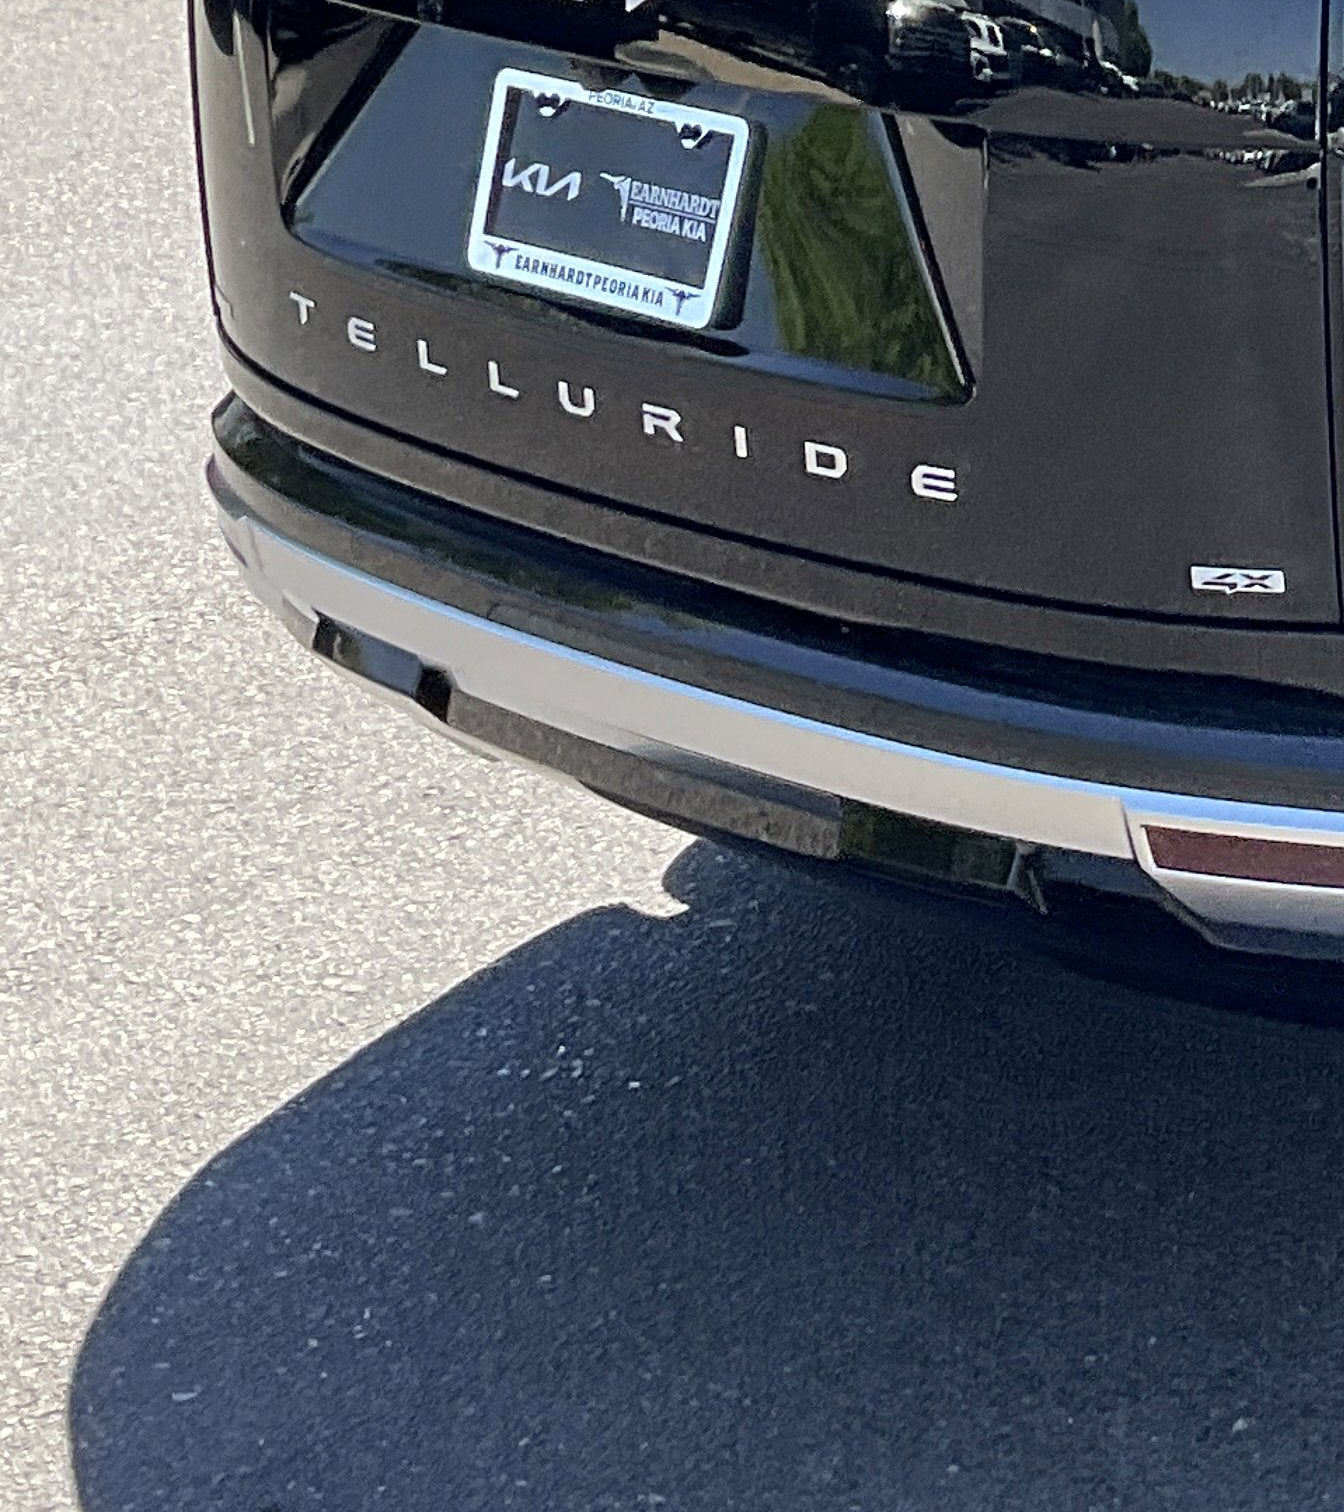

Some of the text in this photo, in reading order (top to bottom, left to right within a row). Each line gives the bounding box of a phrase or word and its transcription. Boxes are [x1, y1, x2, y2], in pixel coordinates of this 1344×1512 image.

[630, 179, 721, 218] EARNHARDT
[632, 206, 707, 242] PEORIA KIA
[642, 287, 664, 307] KIA
[290, 289, 960, 501] TELLURIDE
